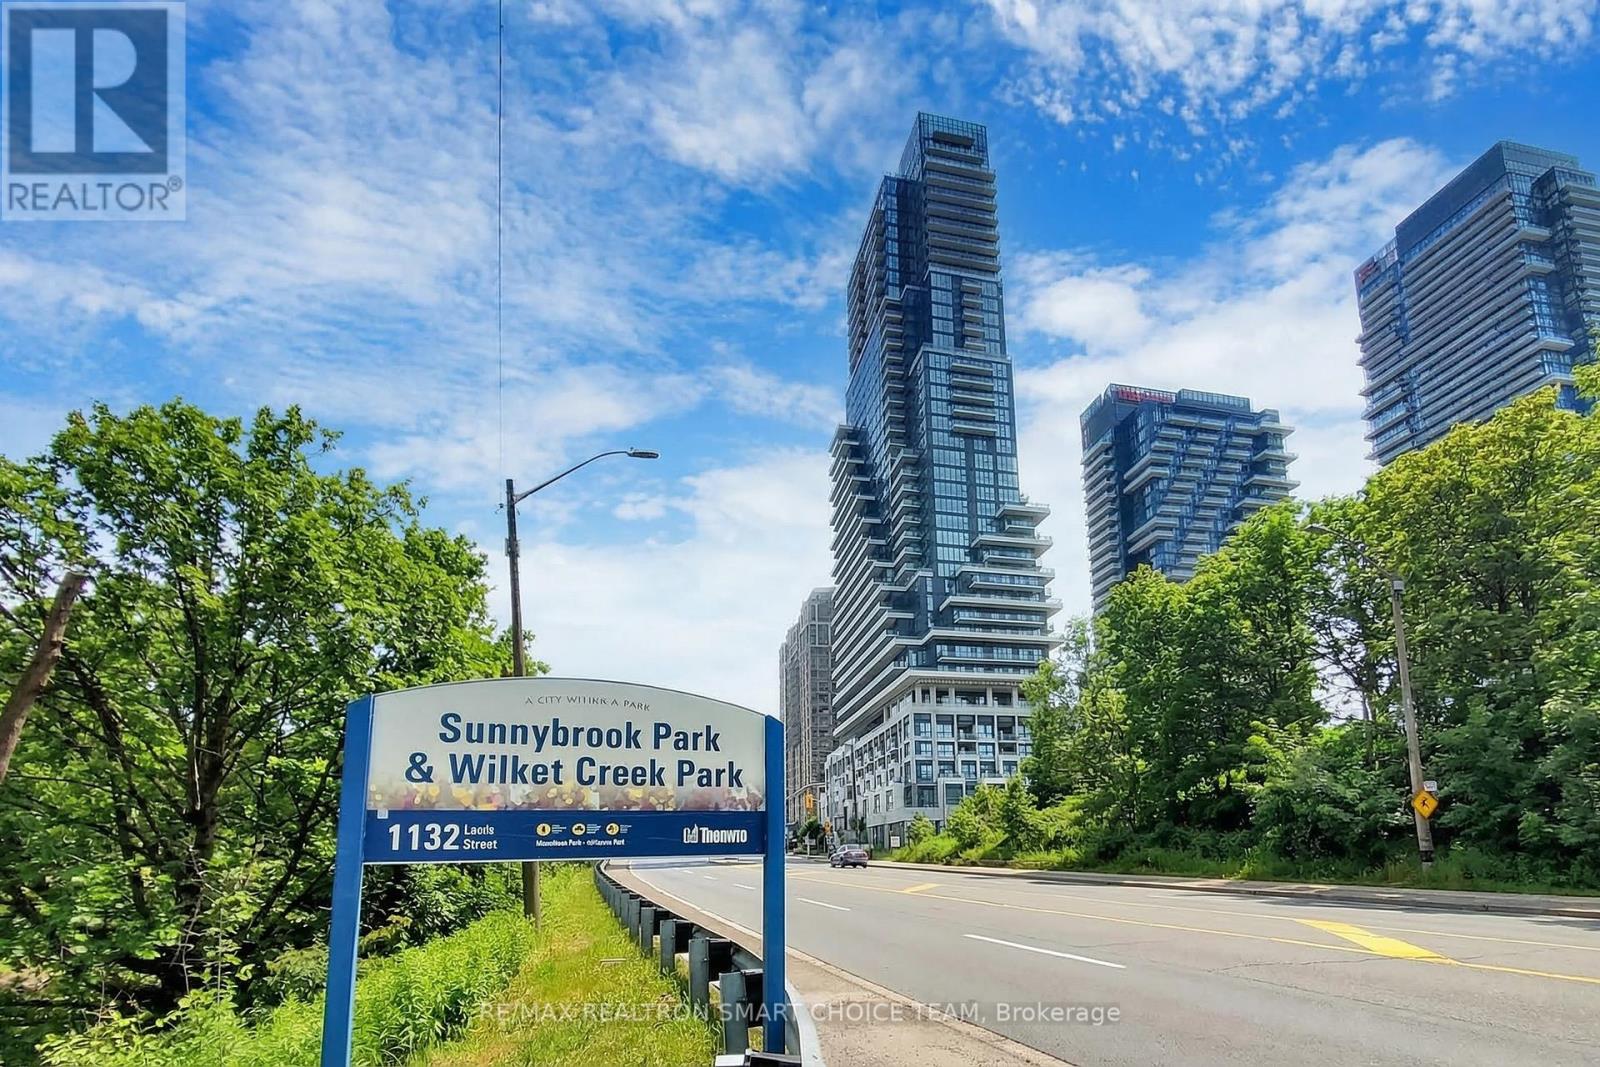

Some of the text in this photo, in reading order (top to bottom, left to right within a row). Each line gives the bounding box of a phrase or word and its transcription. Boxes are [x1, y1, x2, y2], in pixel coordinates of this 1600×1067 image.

[525, 696, 534, 705] A
[537, 695, 562, 705] CITY
[623, 699, 651, 712] PARK
[438, 711, 721, 753] Sunnybrook Park
[404, 751, 743, 788] & Wilket Creek Park
[388, 823, 460, 851] 1132
[462, 838, 498, 850] Street
